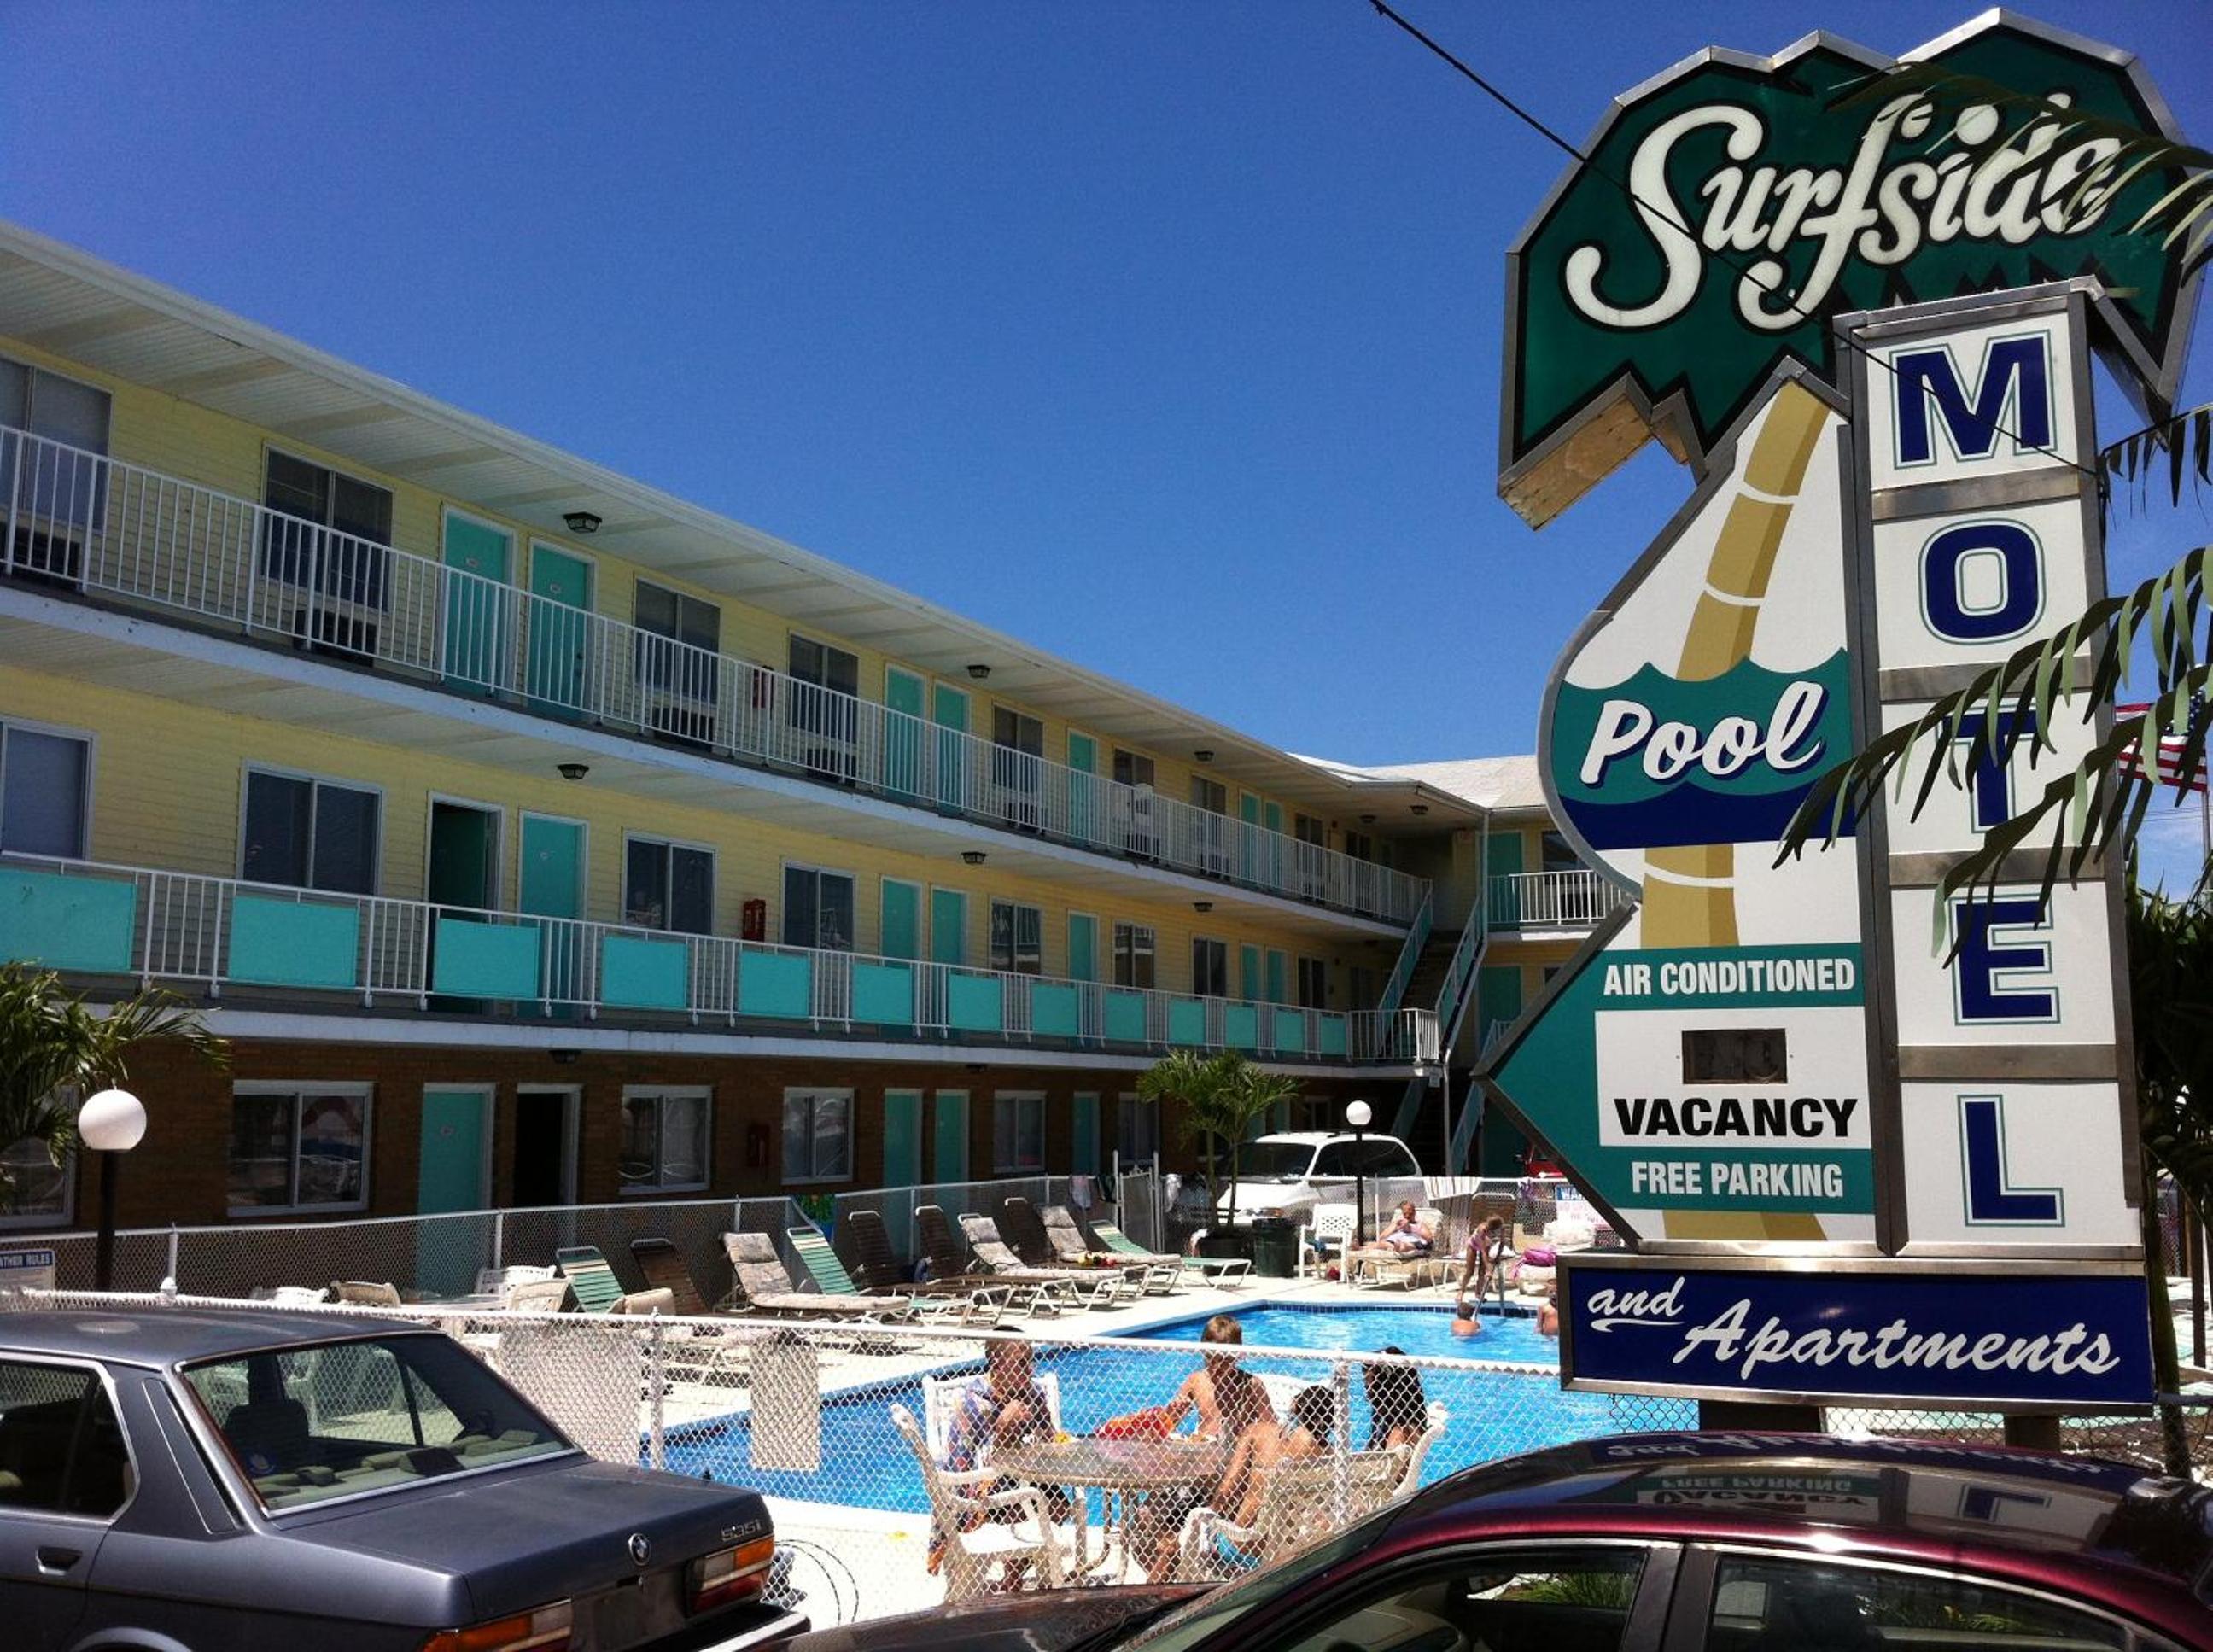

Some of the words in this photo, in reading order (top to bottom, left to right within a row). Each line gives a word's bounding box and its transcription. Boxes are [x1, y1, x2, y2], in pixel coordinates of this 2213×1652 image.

[1566, 93, 2122, 329] Surfside
[1579, 680, 1826, 785] Pool
[1889, 328, 2066, 1228] MOTEL
[1603, 963, 1653, 996] AIR
[1659, 957, 1855, 995] CONDITIONED
[1613, 1098, 1859, 1138] VACANCY
[1631, 1161, 1702, 1194] FREE
[1711, 1162, 1844, 1198] PARKING
[1586, 1276, 1686, 1319] and
[1673, 1298, 2121, 1381] Apartments
